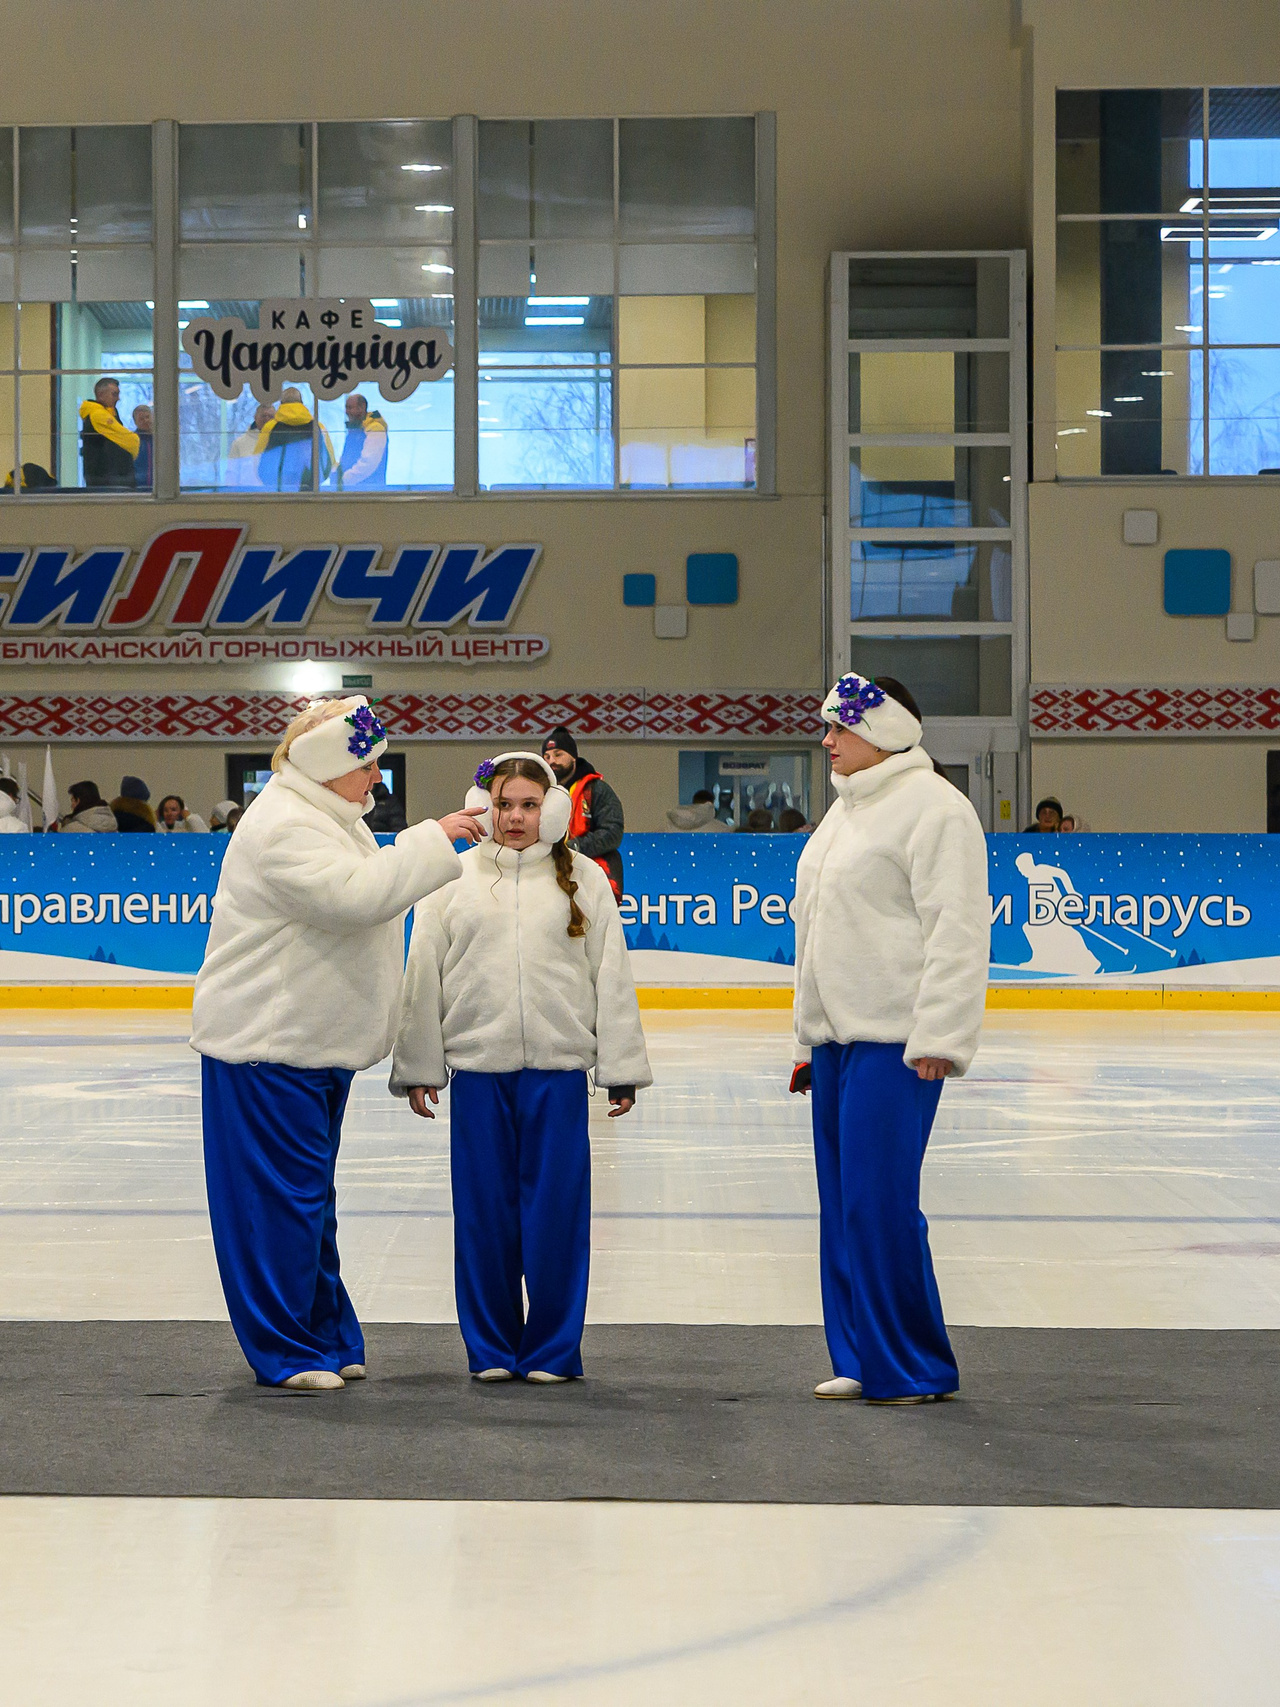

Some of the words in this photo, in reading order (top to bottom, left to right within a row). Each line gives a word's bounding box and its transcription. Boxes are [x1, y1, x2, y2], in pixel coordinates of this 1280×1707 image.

[271, 309, 363, 330] КАФЕ
[193, 328, 443, 392] Чараўніца
[210, 636, 443, 659] ГОРНОЛЫЖНЫЙ
[451, 638, 544, 661] ЦЕНТР
[1028, 883, 1252, 938] Беларусь
